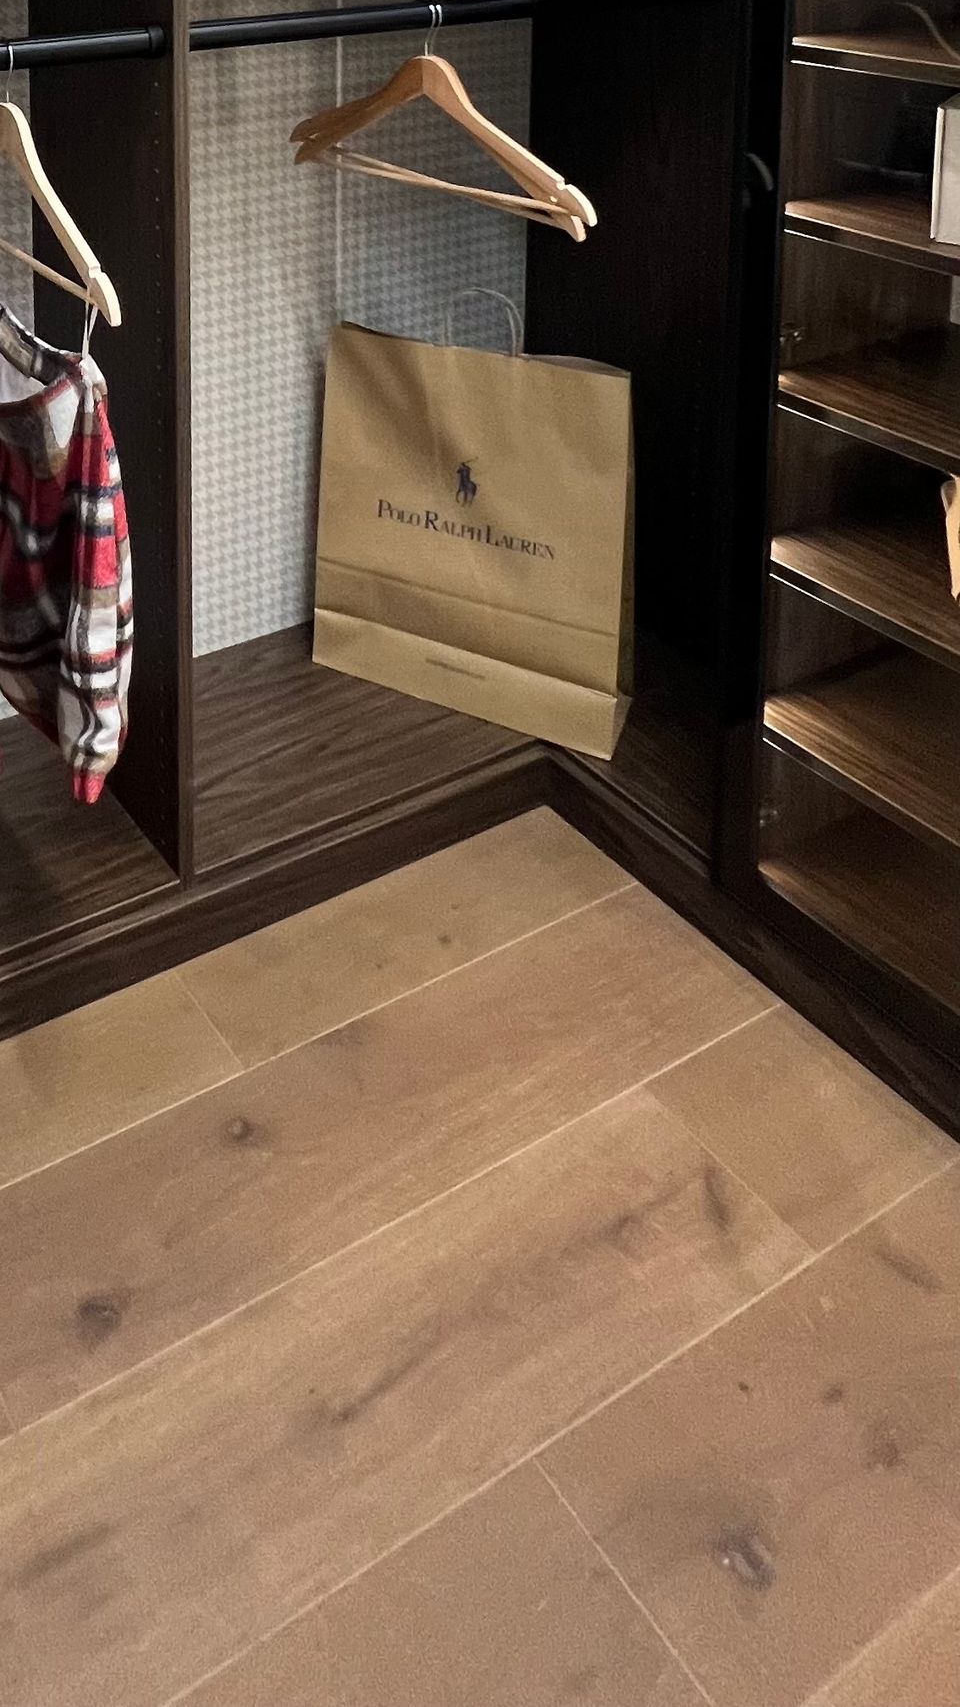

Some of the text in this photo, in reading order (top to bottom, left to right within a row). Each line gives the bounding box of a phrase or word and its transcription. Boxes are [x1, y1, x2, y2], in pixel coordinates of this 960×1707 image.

[377, 499, 555, 560] POLO RALPH LAUREN
